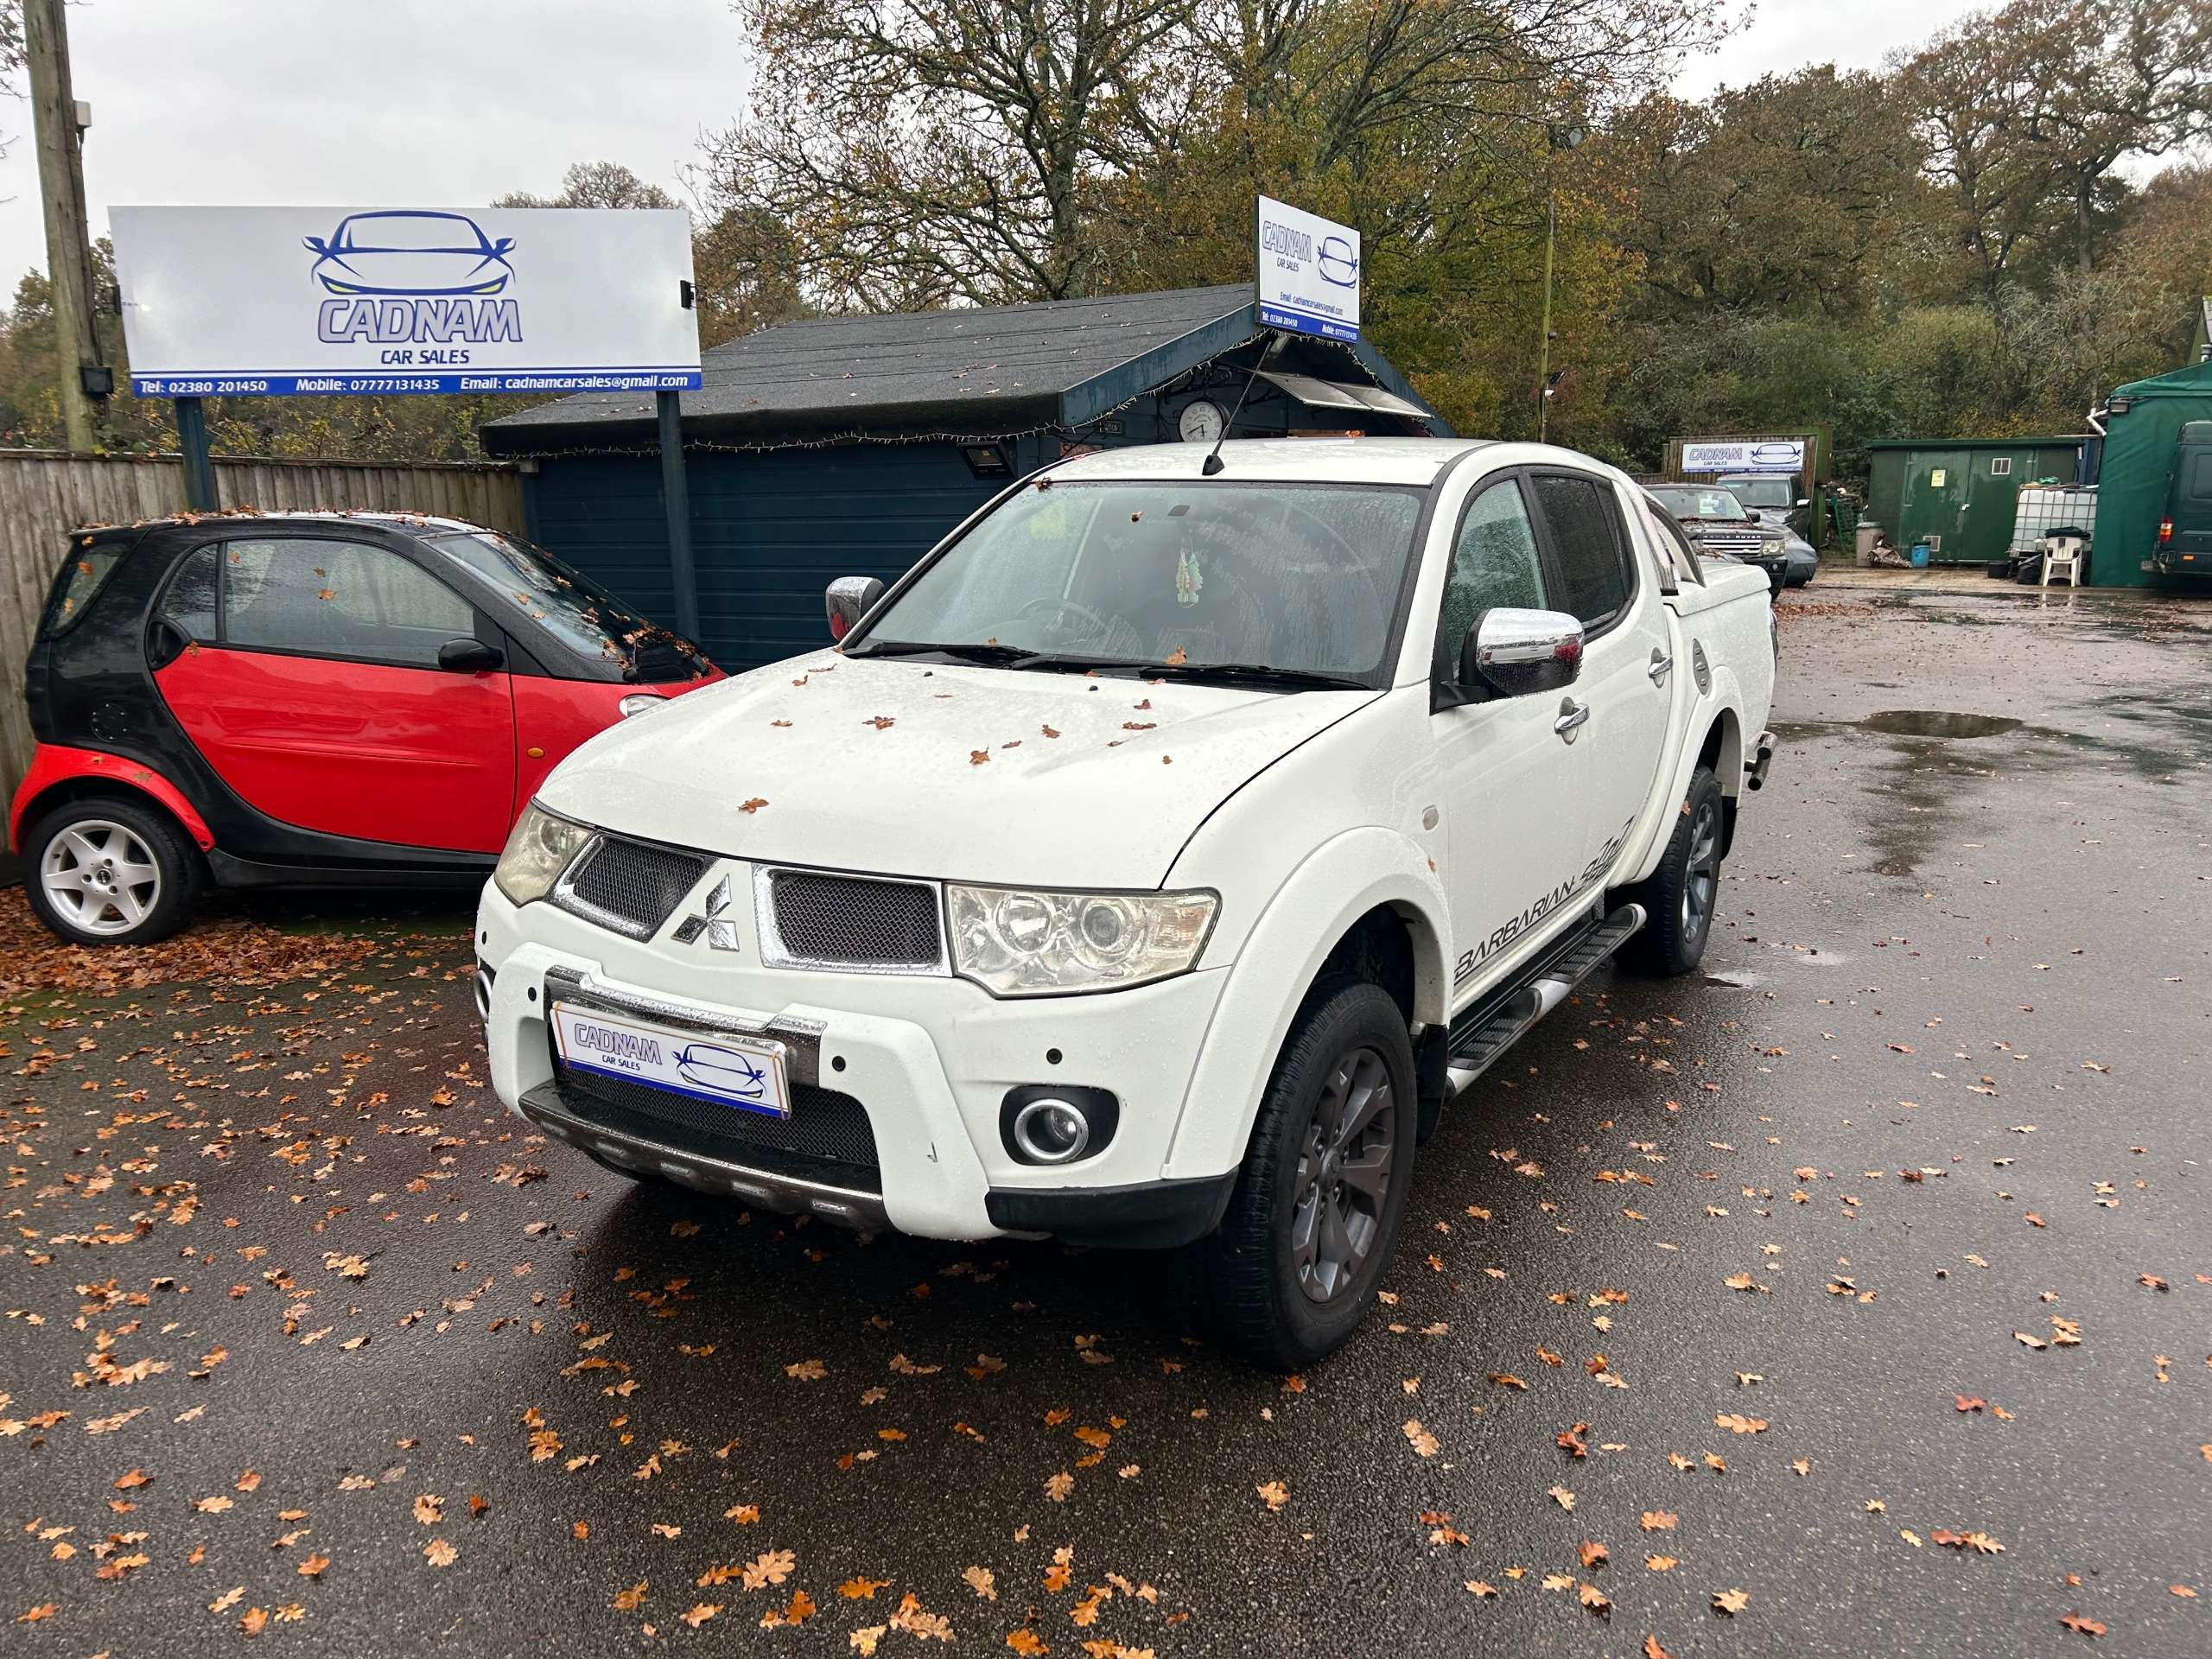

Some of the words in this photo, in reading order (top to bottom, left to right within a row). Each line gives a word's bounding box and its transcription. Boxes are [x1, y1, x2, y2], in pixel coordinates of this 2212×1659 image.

[1262, 220, 1312, 263] CADNAM
[1287, 260, 1300, 271] SALES
[318, 299, 523, 343] CADNAM
[381, 350, 413, 364] CAR
[419, 349, 470, 364] SALES
[140, 380, 165, 393] Tel:
[168, 381, 213, 393] 02380
[217, 380, 267, 392] 201450
[296, 378, 346, 391] Mobile:
[351, 378, 440, 391] 07777131435
[461, 377, 502, 389] Email:
[505, 375, 688, 389] cadnamcarsales@gmail.com
[1689, 448, 1742, 461] CADNAM
[1454, 875, 1576, 980] BARBARIAN
[574, 1023, 663, 1065] CADNAM
[602, 1055, 616, 1065] CAR
[618, 1058, 640, 1071] SALES
